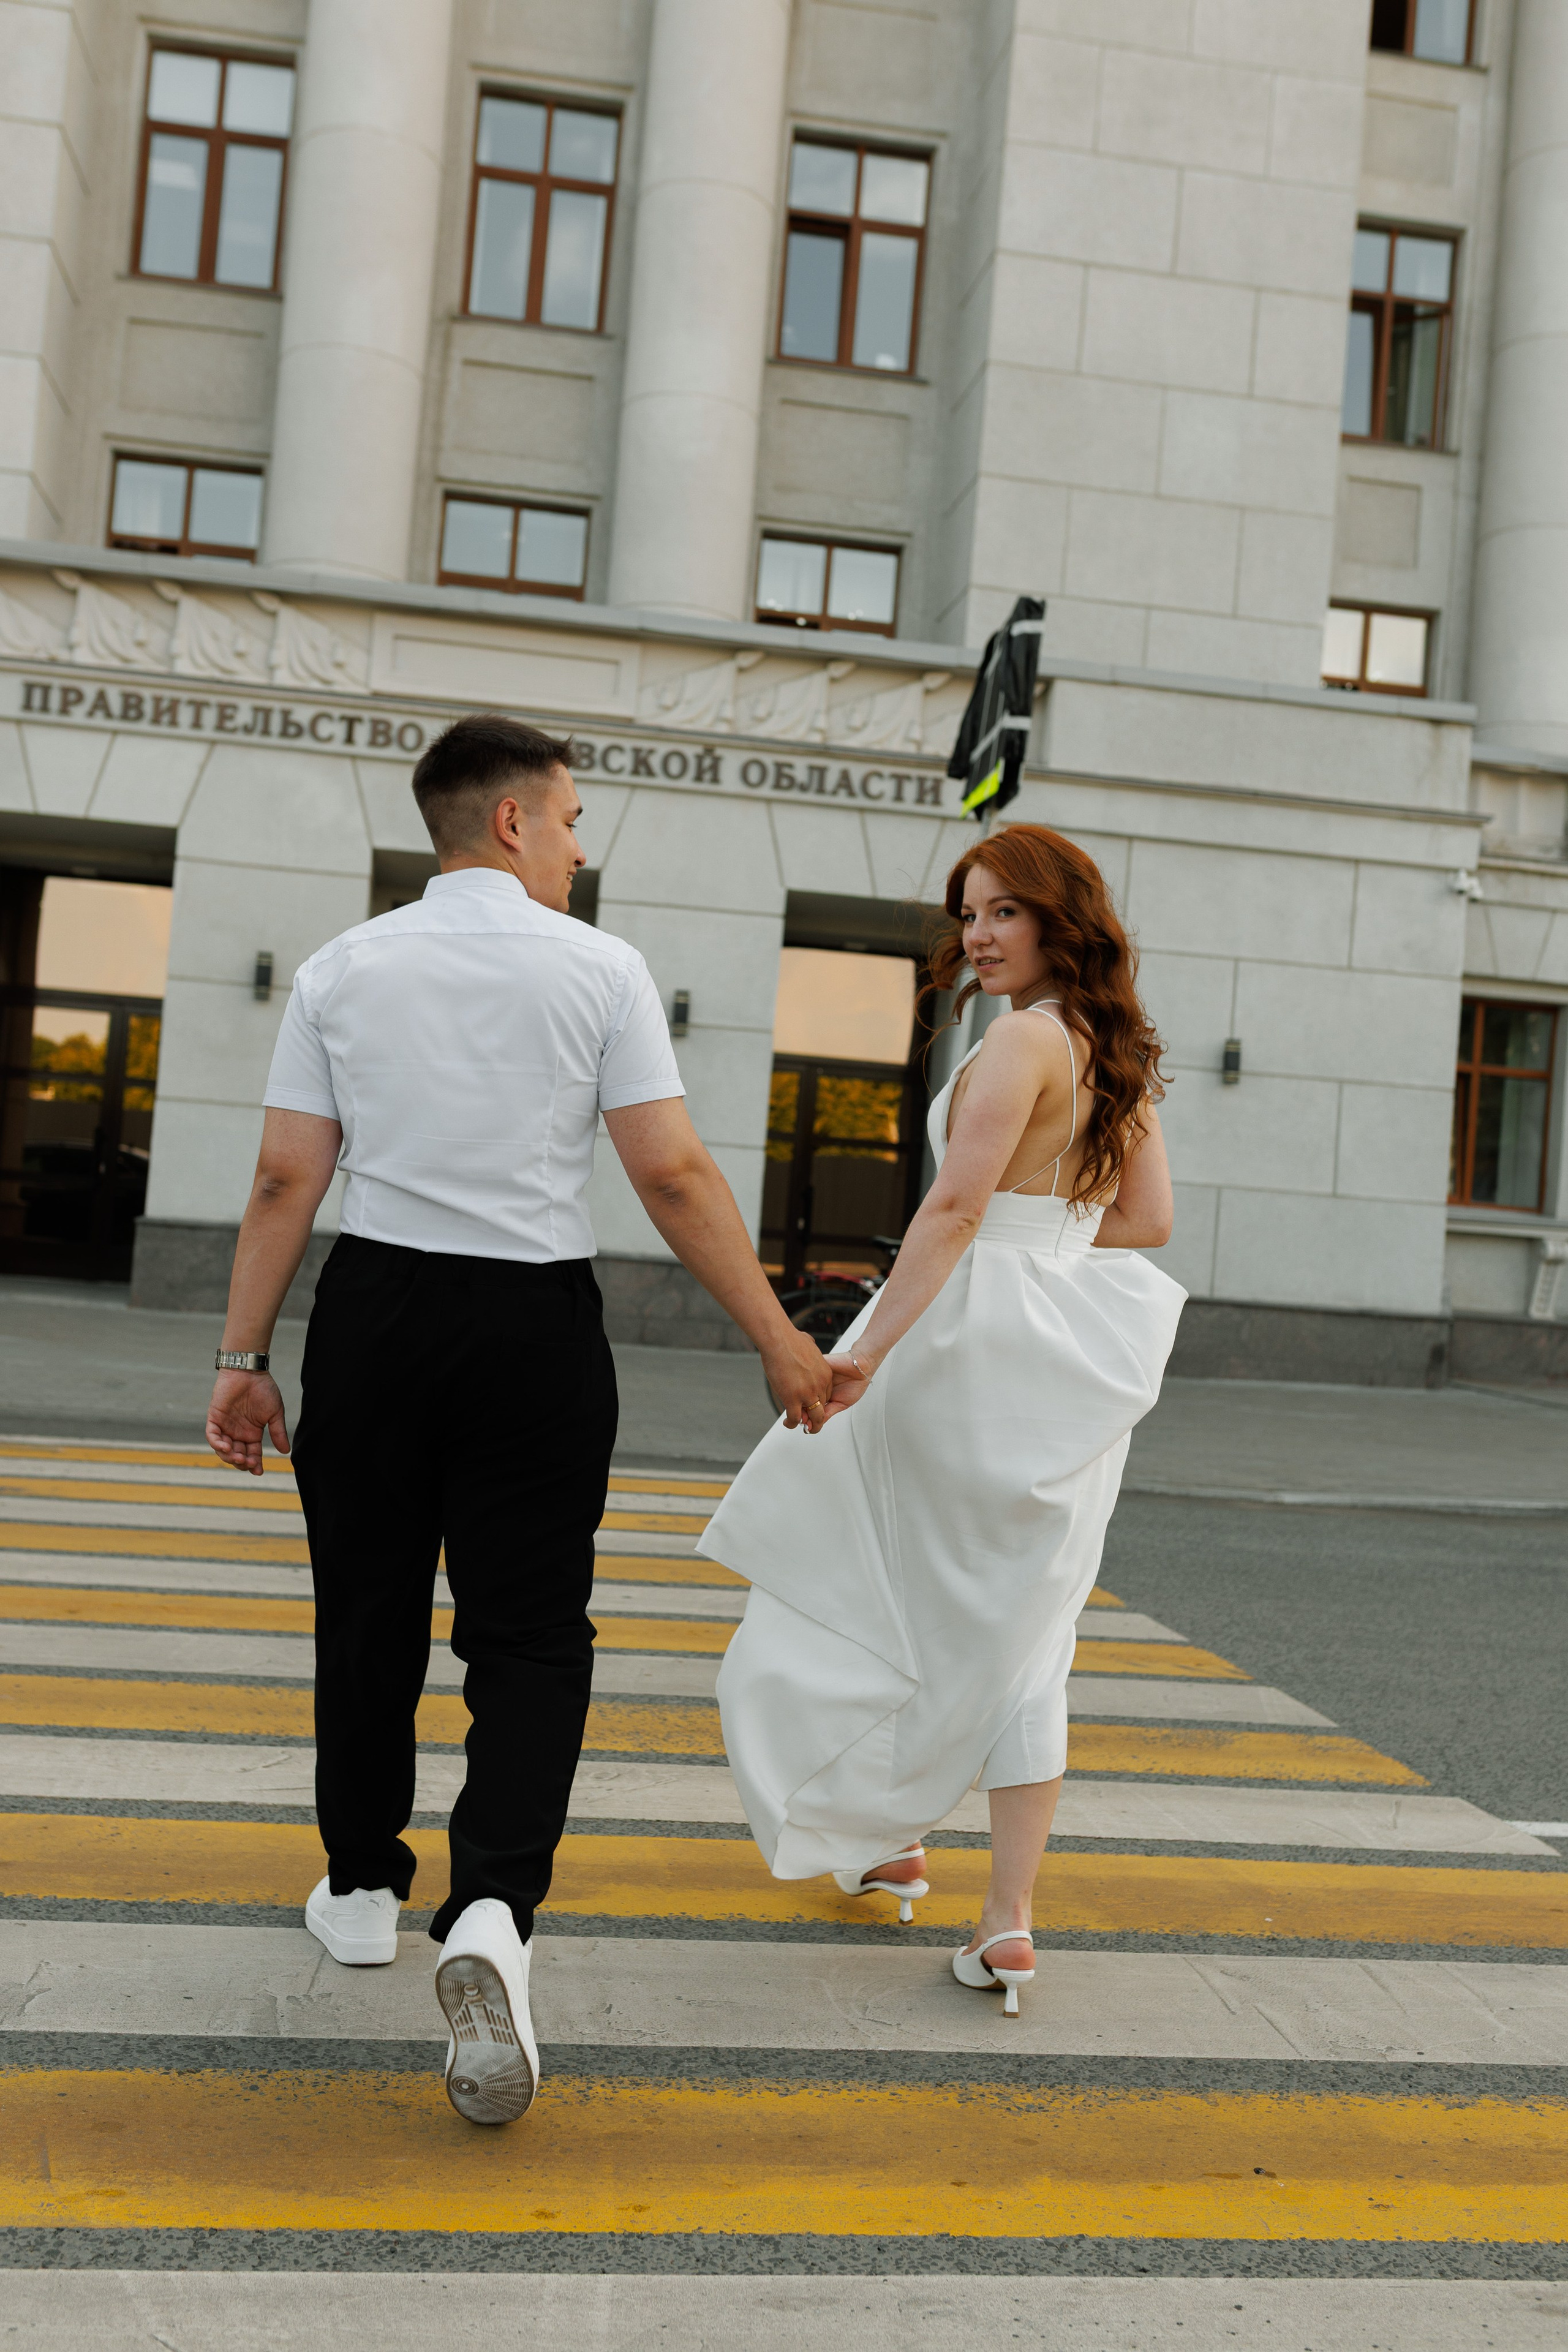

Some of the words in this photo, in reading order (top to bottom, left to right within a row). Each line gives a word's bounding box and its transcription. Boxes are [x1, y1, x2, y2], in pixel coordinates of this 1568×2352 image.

[22, 681, 425, 752] ПРАВИТЕЛЬСТВО
[574, 742, 723, 784] ВСКОЙ
[742, 758, 944, 806] ОБЛАСТИ
